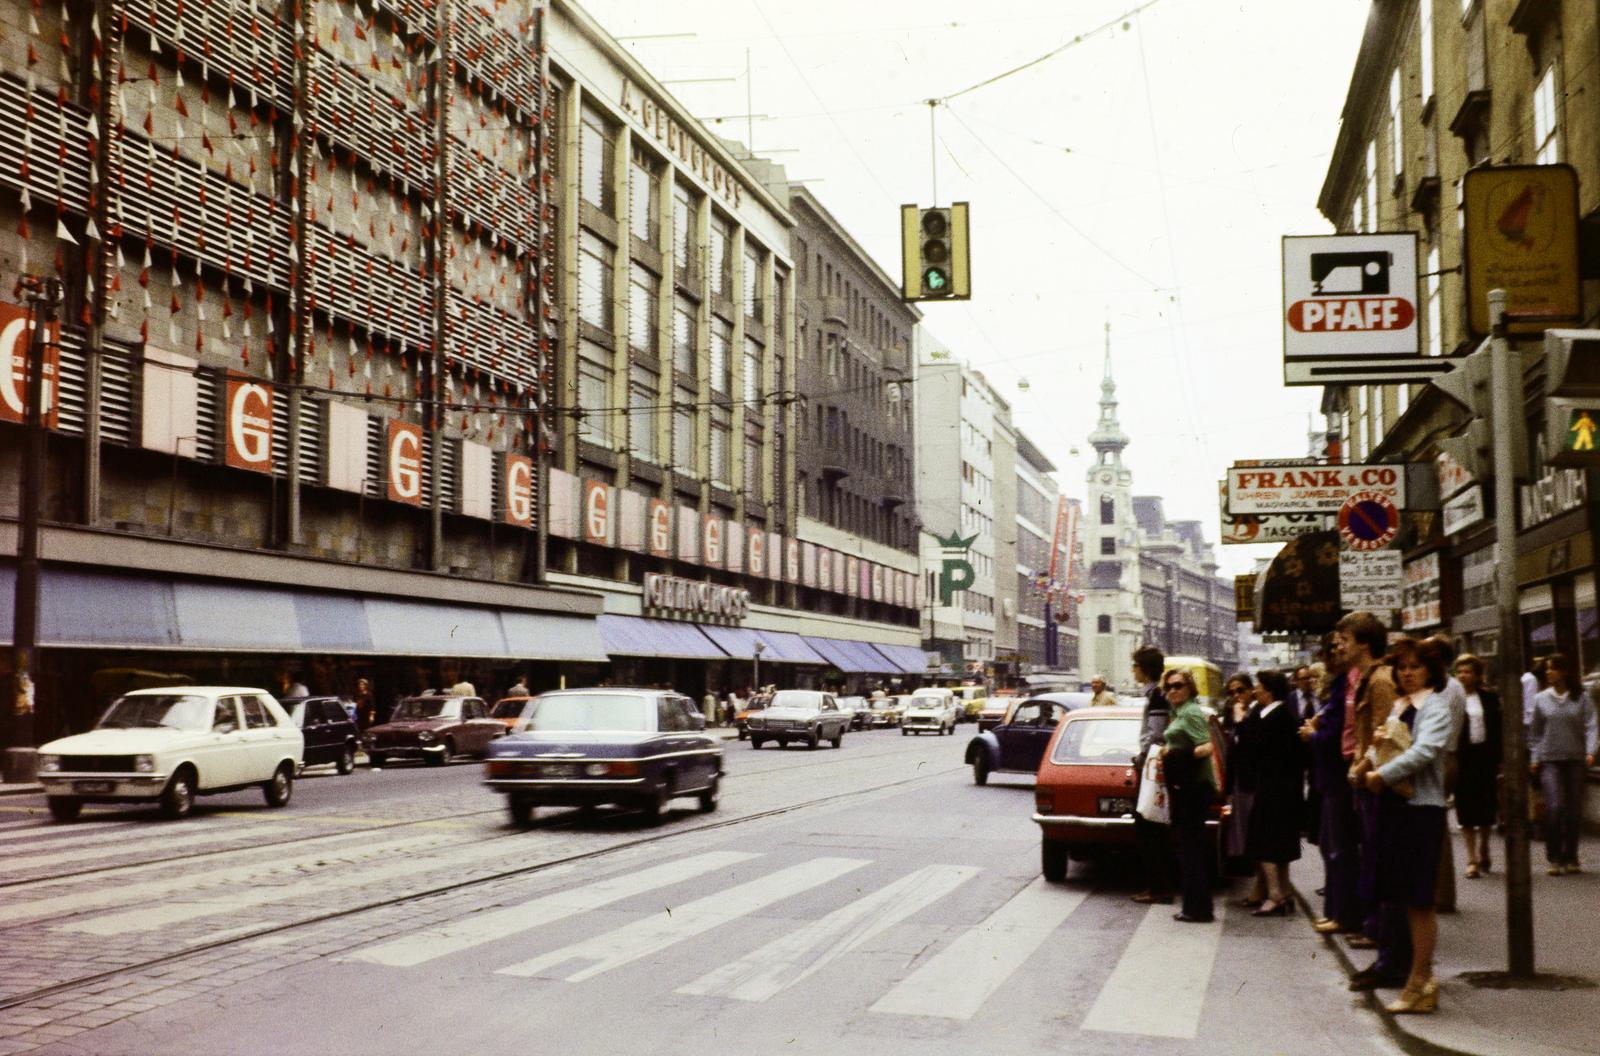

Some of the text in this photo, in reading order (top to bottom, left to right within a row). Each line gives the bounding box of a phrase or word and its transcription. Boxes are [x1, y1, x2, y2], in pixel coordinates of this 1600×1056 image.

[1302, 301, 1400, 331] PFAFF
[231, 383, 270, 463] G
[390, 430, 419, 498] G
[1237, 468, 1397, 489] FRANK & CO
[509, 461, 530, 521] G
[588, 487, 607, 538] G
[1236, 490, 1281, 501] UHREN
[1293, 488, 1350, 500] JUWELEN
[653, 505, 668, 551] G
[1340, 526, 1397, 550] VERBOTEN
[943, 559, 975, 607] P
